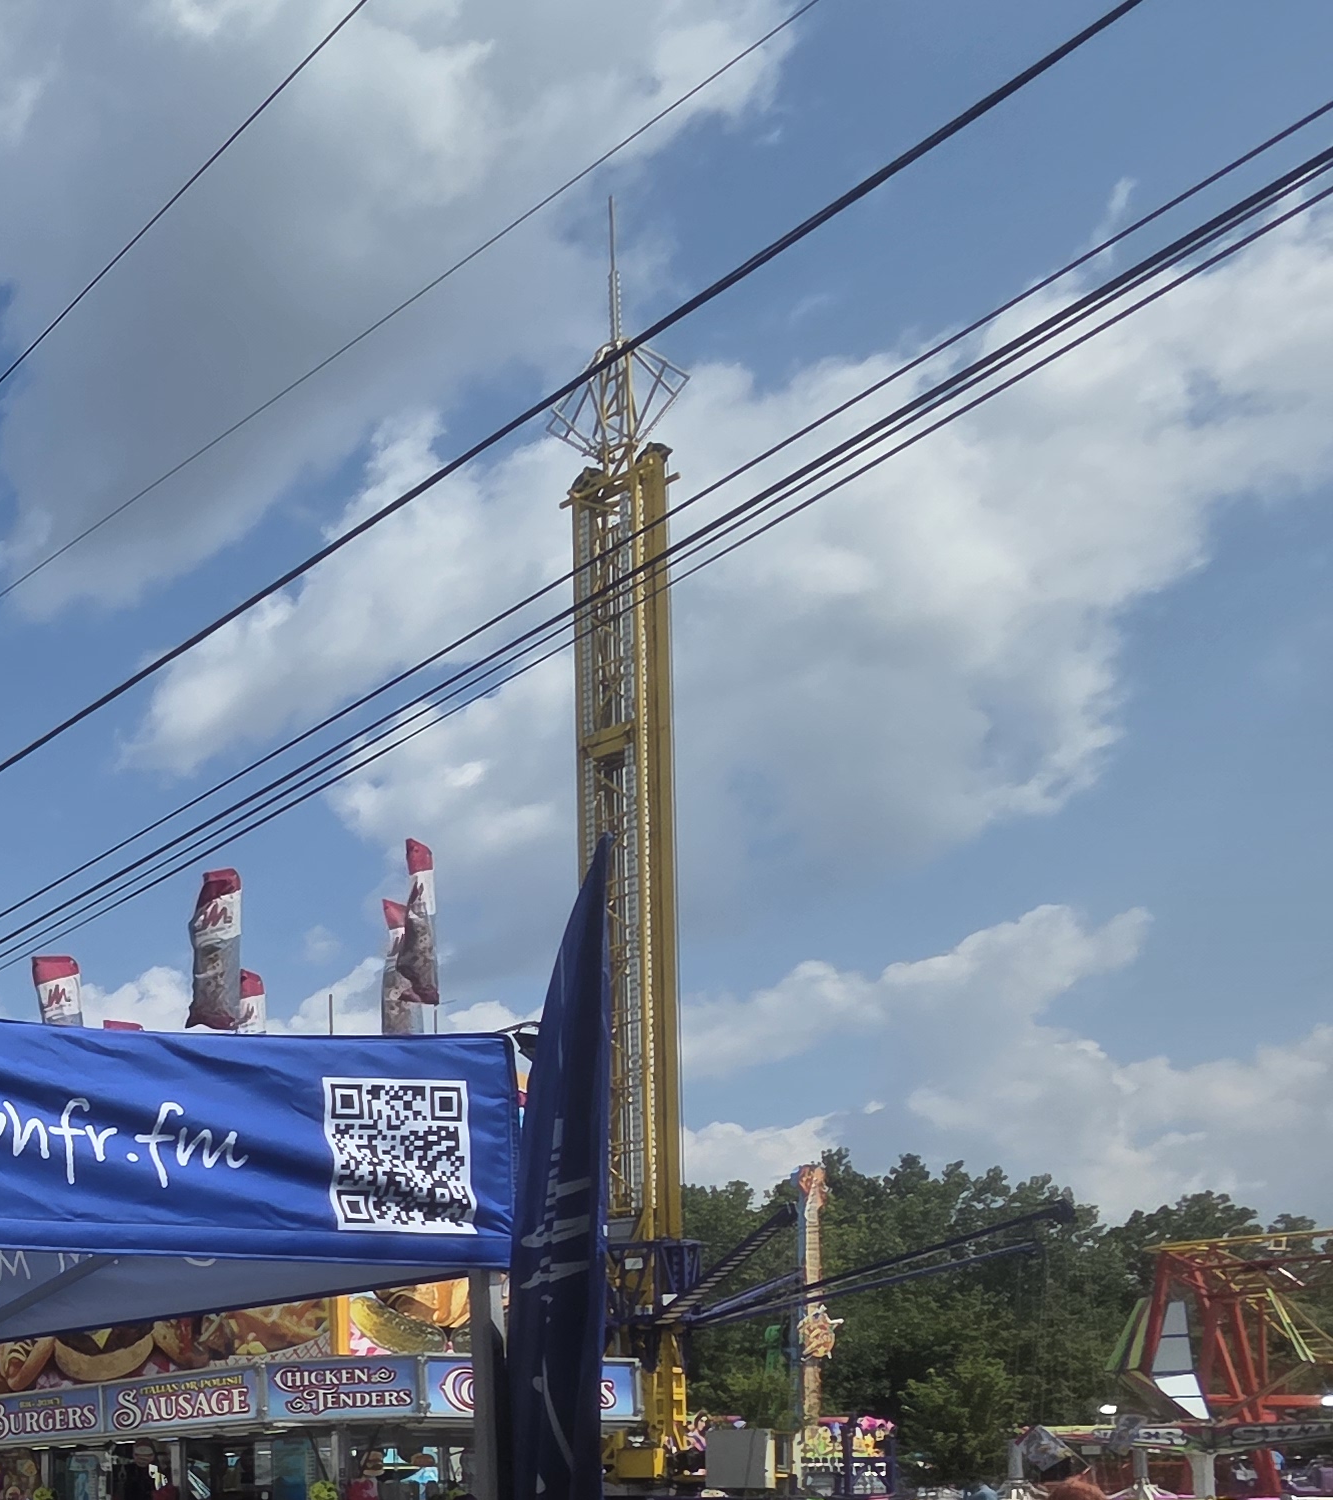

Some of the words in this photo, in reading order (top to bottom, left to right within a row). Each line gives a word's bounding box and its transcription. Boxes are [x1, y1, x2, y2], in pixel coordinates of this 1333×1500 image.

[181, 1380, 199, 1391] OR
[274, 1367, 369, 1389] CHICKEN
[113, 1387, 249, 1430] SAUSAGE
[303, 1388, 412, 1414] TENDERS
